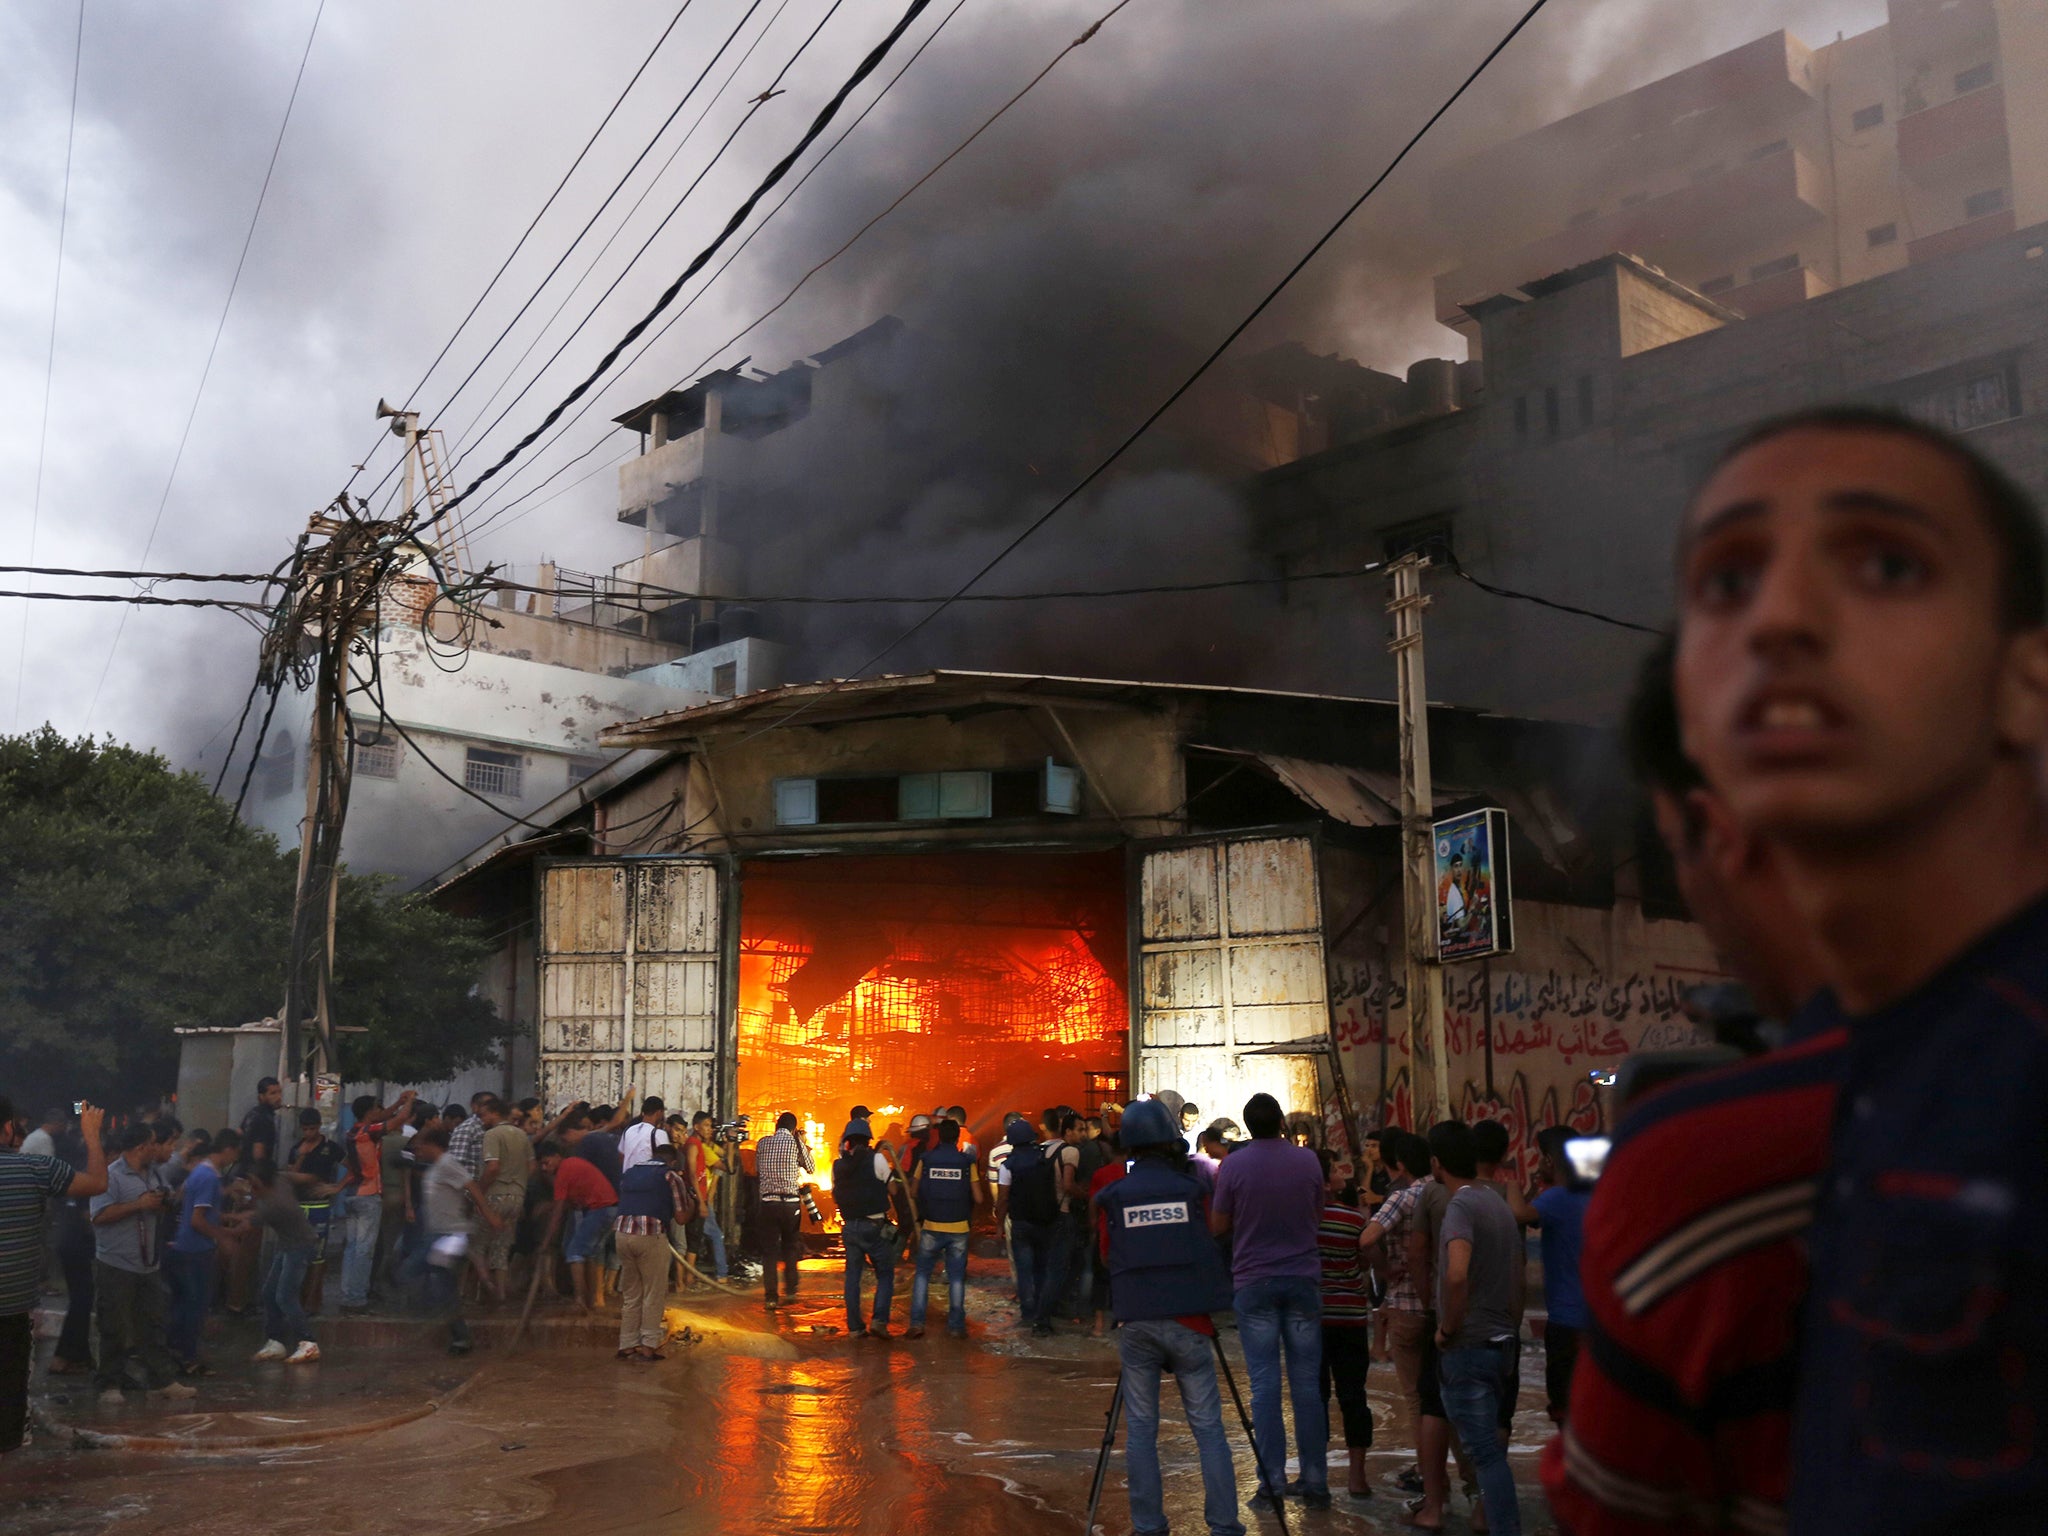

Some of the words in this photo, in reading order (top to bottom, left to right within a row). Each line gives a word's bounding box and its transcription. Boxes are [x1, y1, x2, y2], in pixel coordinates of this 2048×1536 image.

[1557, 1018, 1630, 1065] كتائب
[931, 1168, 961, 1179] PRESS
[1128, 1206, 1185, 1224] PRESS
